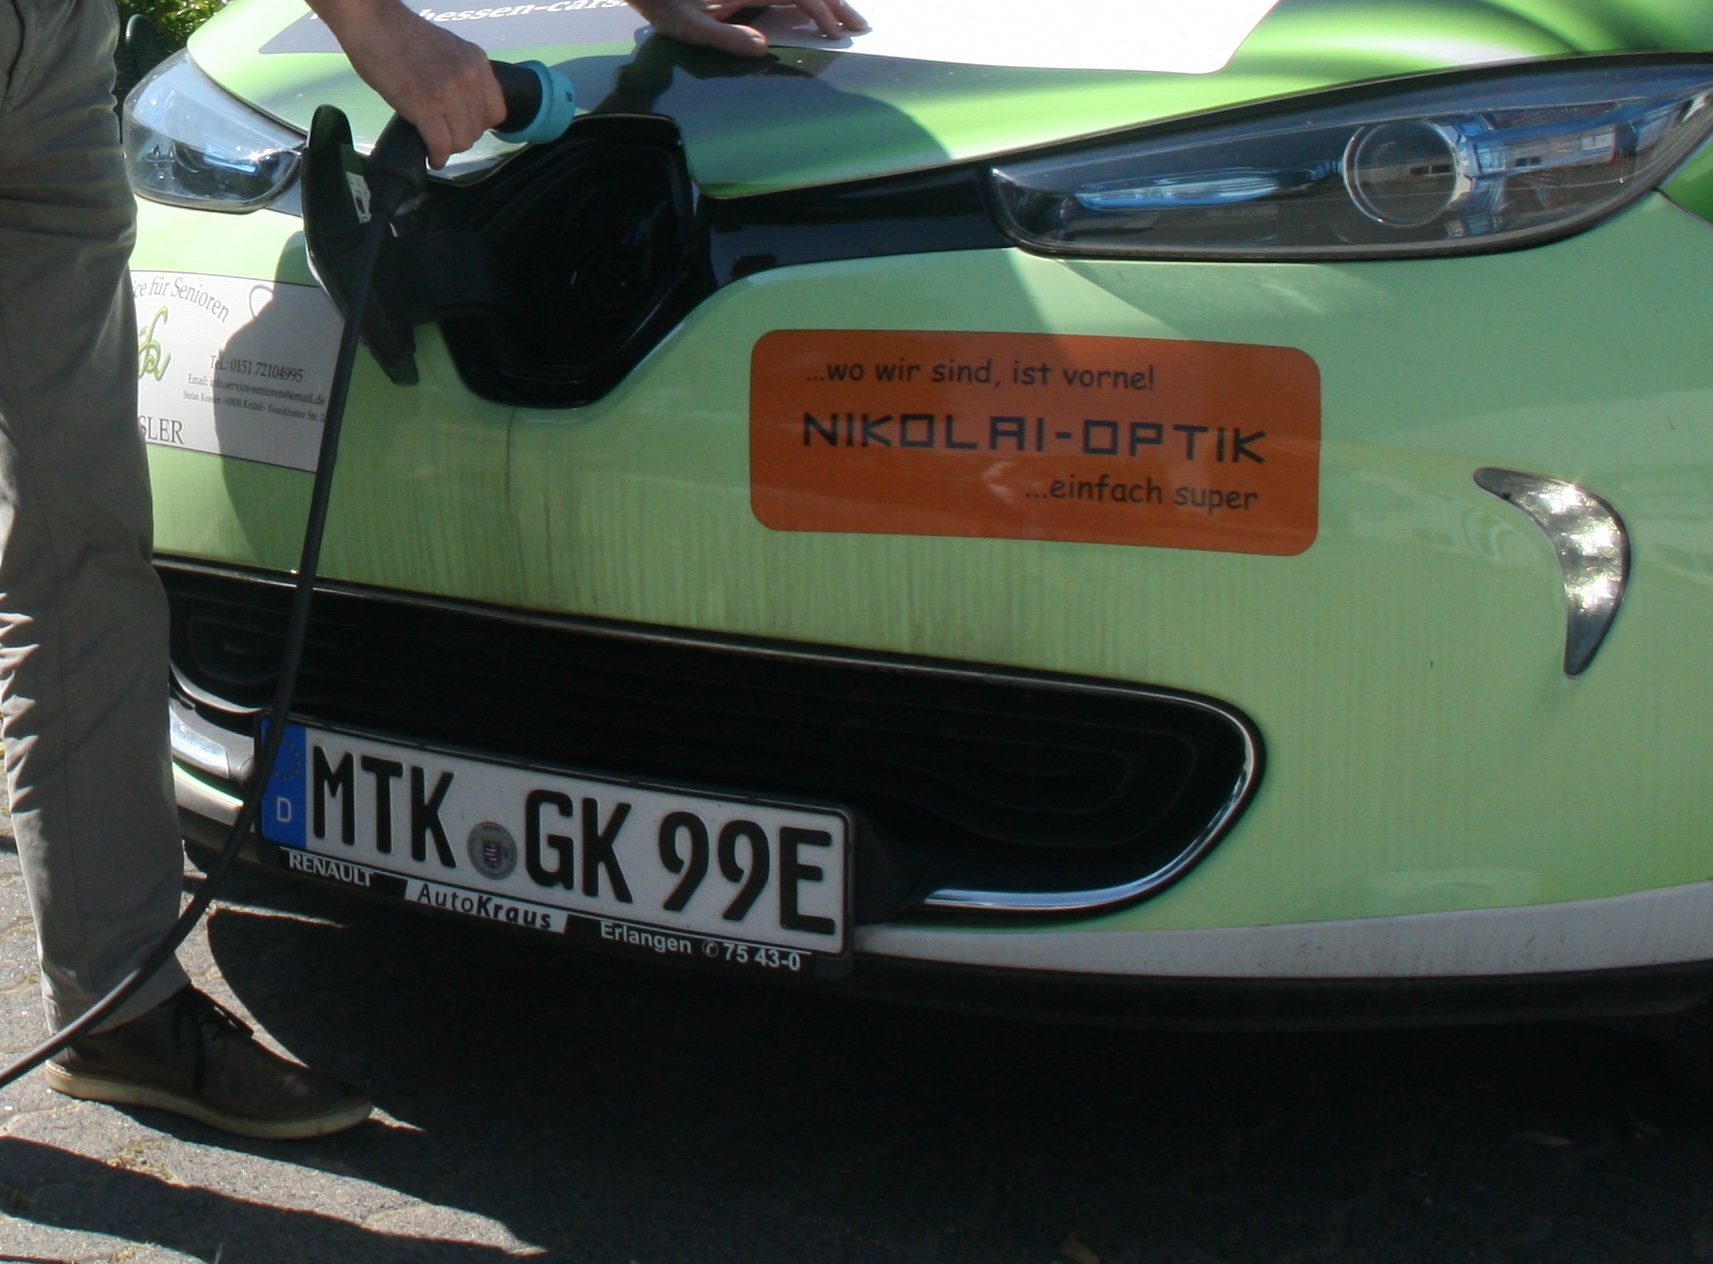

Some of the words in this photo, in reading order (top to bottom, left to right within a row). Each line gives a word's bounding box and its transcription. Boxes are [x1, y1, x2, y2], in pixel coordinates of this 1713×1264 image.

[149, 275, 170, 296] für
[171, 276, 230, 323] Senioren
[230, 358, 253, 375] 0151
[255, 362, 304, 383] 72104995
[875, 359, 922, 383] wir
[930, 357, 1002, 388] sind,
[1012, 360, 1051, 386] ist
[1063, 363, 1155, 390] vorne!
[138, 415, 184, 445] SLER
[803, 412, 1266, 464] NIKOLAI-OPTIK
[1173, 485, 1260, 515] super
[276, 797, 292, 822] D
[312, 744, 457, 870] MTK
[525, 788, 634, 904] GK
[658, 810, 836, 936] 99E
[289, 851, 374, 887] RENAULT
[418, 883, 552, 930] AutoKraus
[600, 920, 692, 955] Erlangen
[723, 942, 749, 963] 75
[754, 949, 802, 972] 43-0
